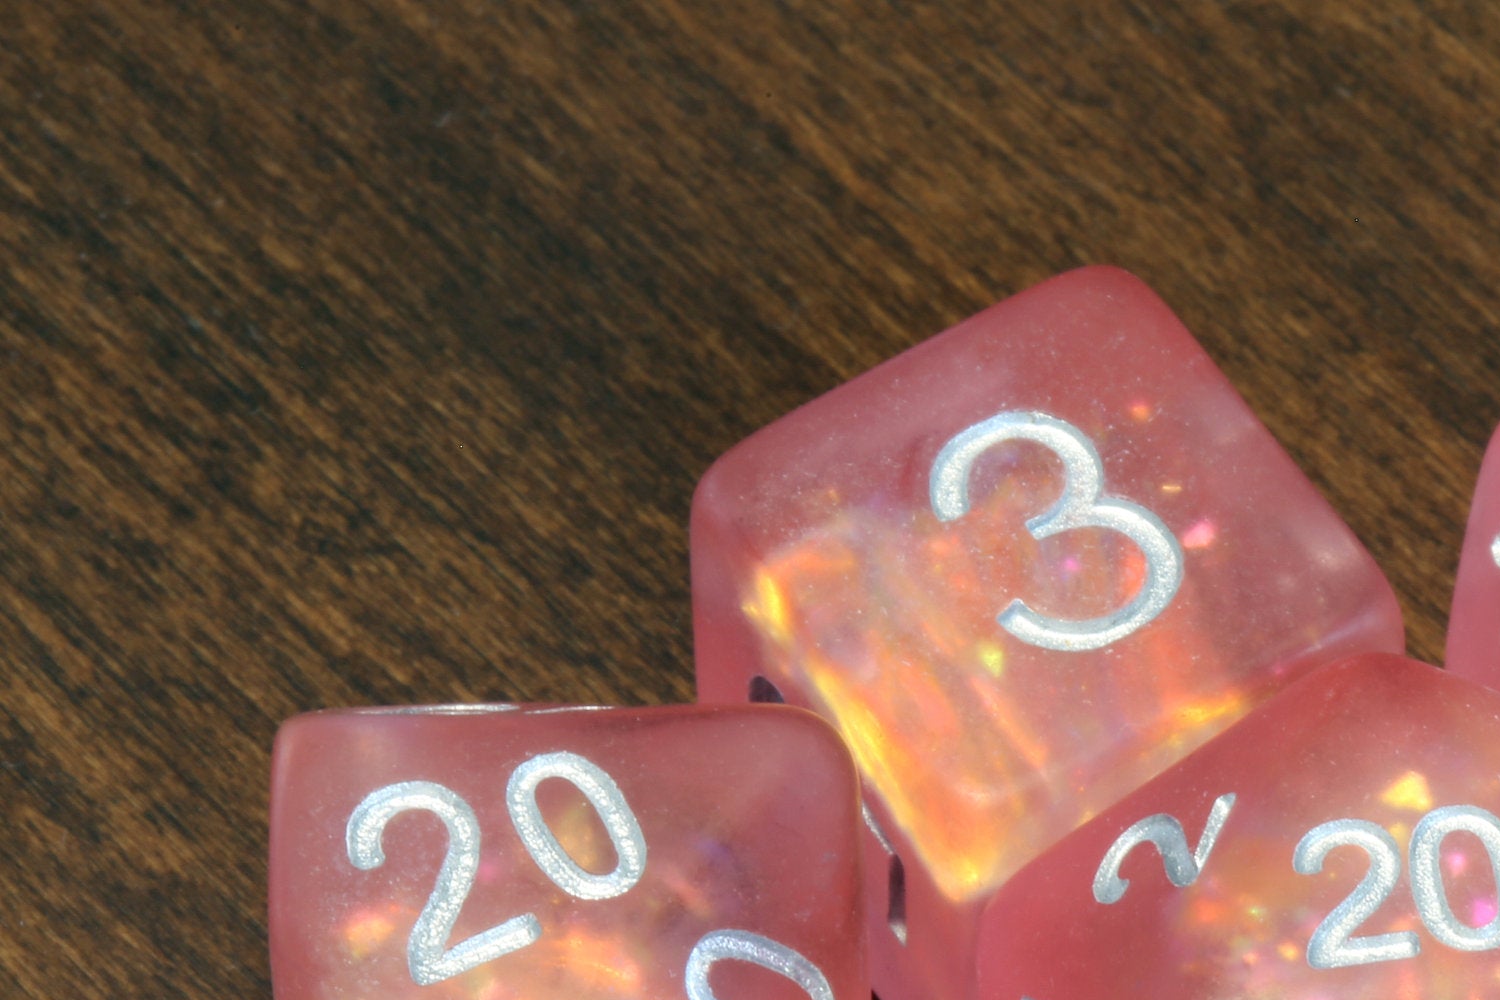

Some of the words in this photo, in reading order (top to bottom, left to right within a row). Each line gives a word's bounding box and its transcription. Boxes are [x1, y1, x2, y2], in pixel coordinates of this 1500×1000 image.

[929, 410, 1184, 652] 3
[346, 751, 647, 987] 20
[1093, 792, 1237, 905] 2
